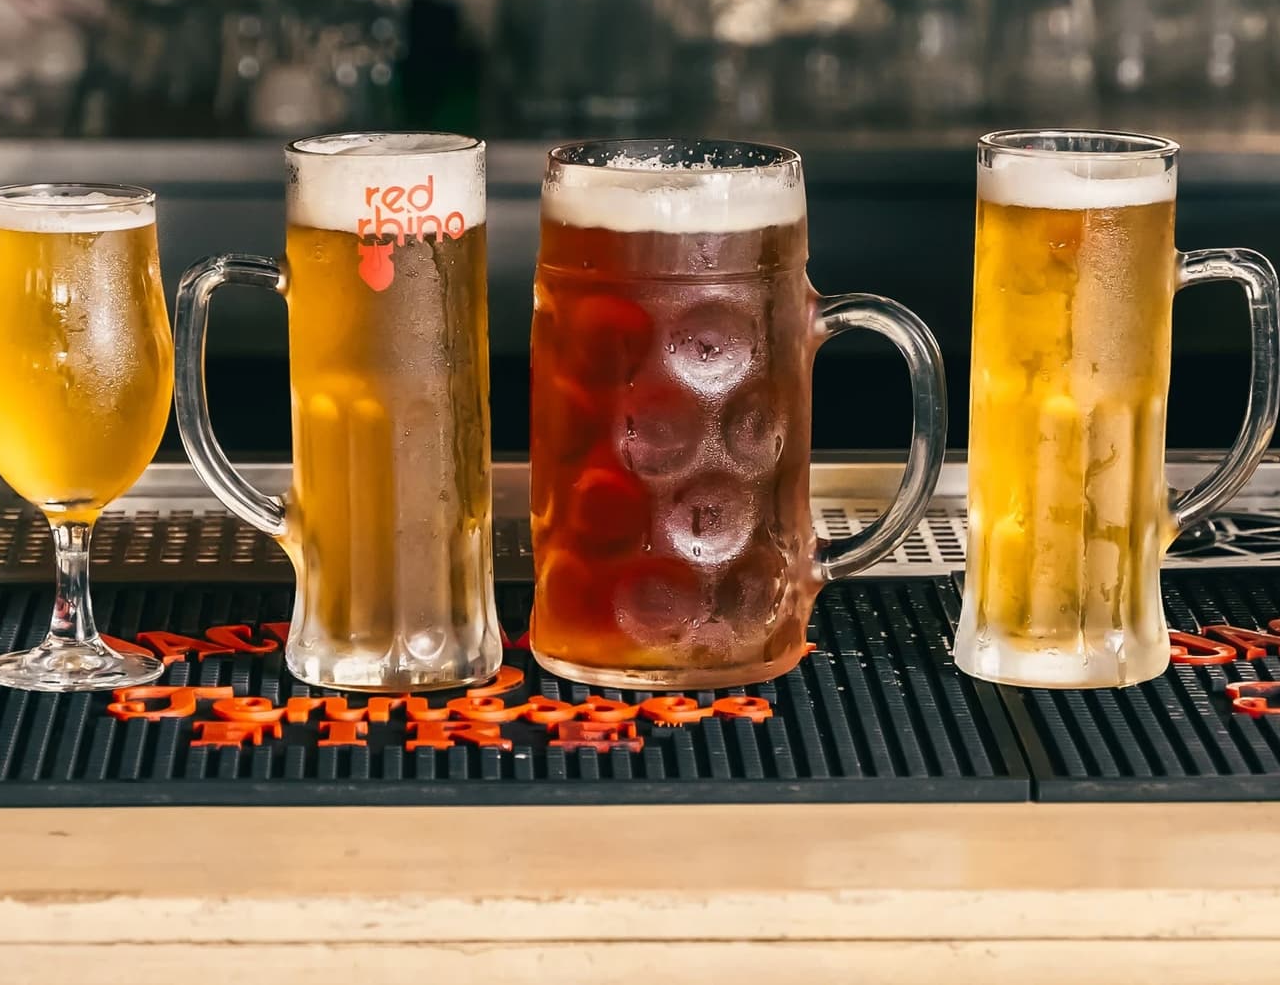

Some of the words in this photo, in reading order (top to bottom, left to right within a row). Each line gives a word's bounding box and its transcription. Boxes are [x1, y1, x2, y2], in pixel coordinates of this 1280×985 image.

[365, 174, 434, 214] red
[357, 205, 466, 247] rhino
[189, 720, 644, 752] FIRE
